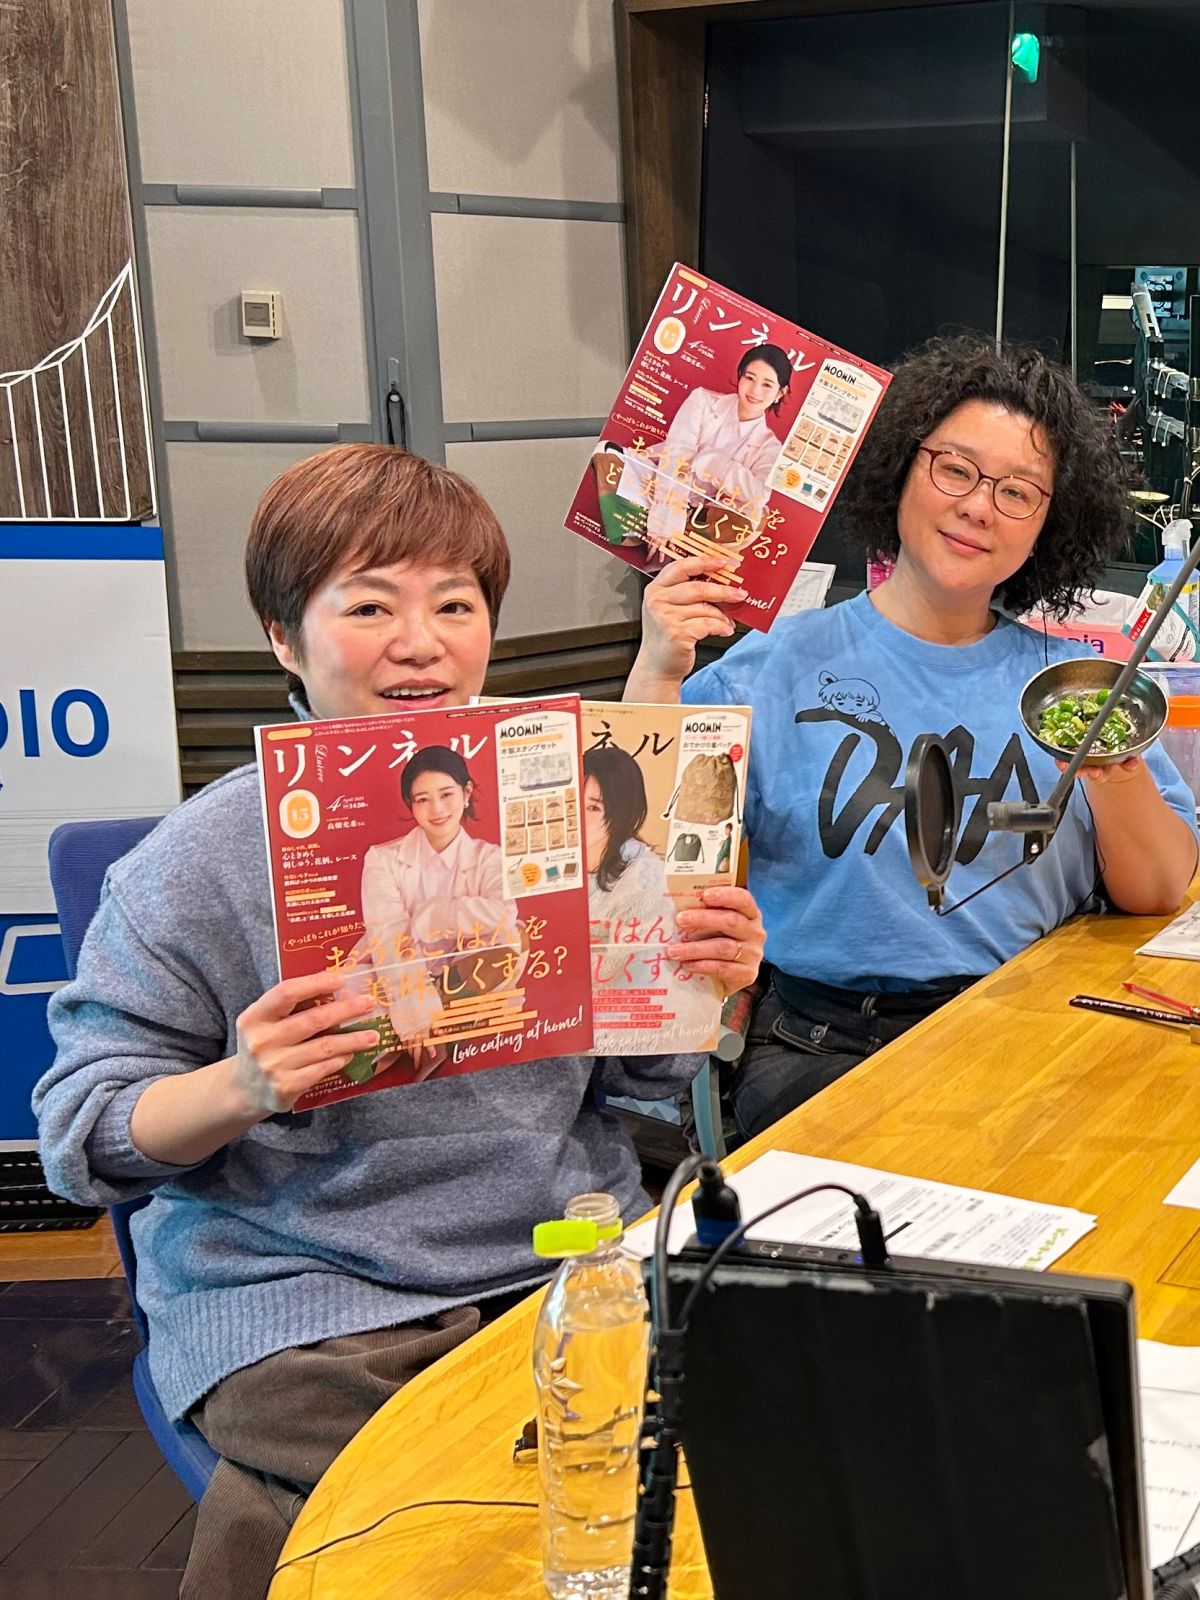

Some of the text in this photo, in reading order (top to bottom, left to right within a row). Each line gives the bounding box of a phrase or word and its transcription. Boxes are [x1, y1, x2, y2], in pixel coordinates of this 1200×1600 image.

[671, 282, 816, 374] リンネル
[823, 363, 857, 386] MOOMIN
[743, 594, 776, 612] ome!
[0, 688, 109, 758] IO
[500, 723, 543, 739] MOOMIN
[684, 722, 722, 733] MOOMIN
[273, 729, 488, 788] リンネル
[326, 915, 548, 976] おうちごはんを
[594, 953, 705, 984] しくする
[361, 945, 568, 1007] 美味しくする?
[453, 1005, 584, 1064] Love eating at home!
